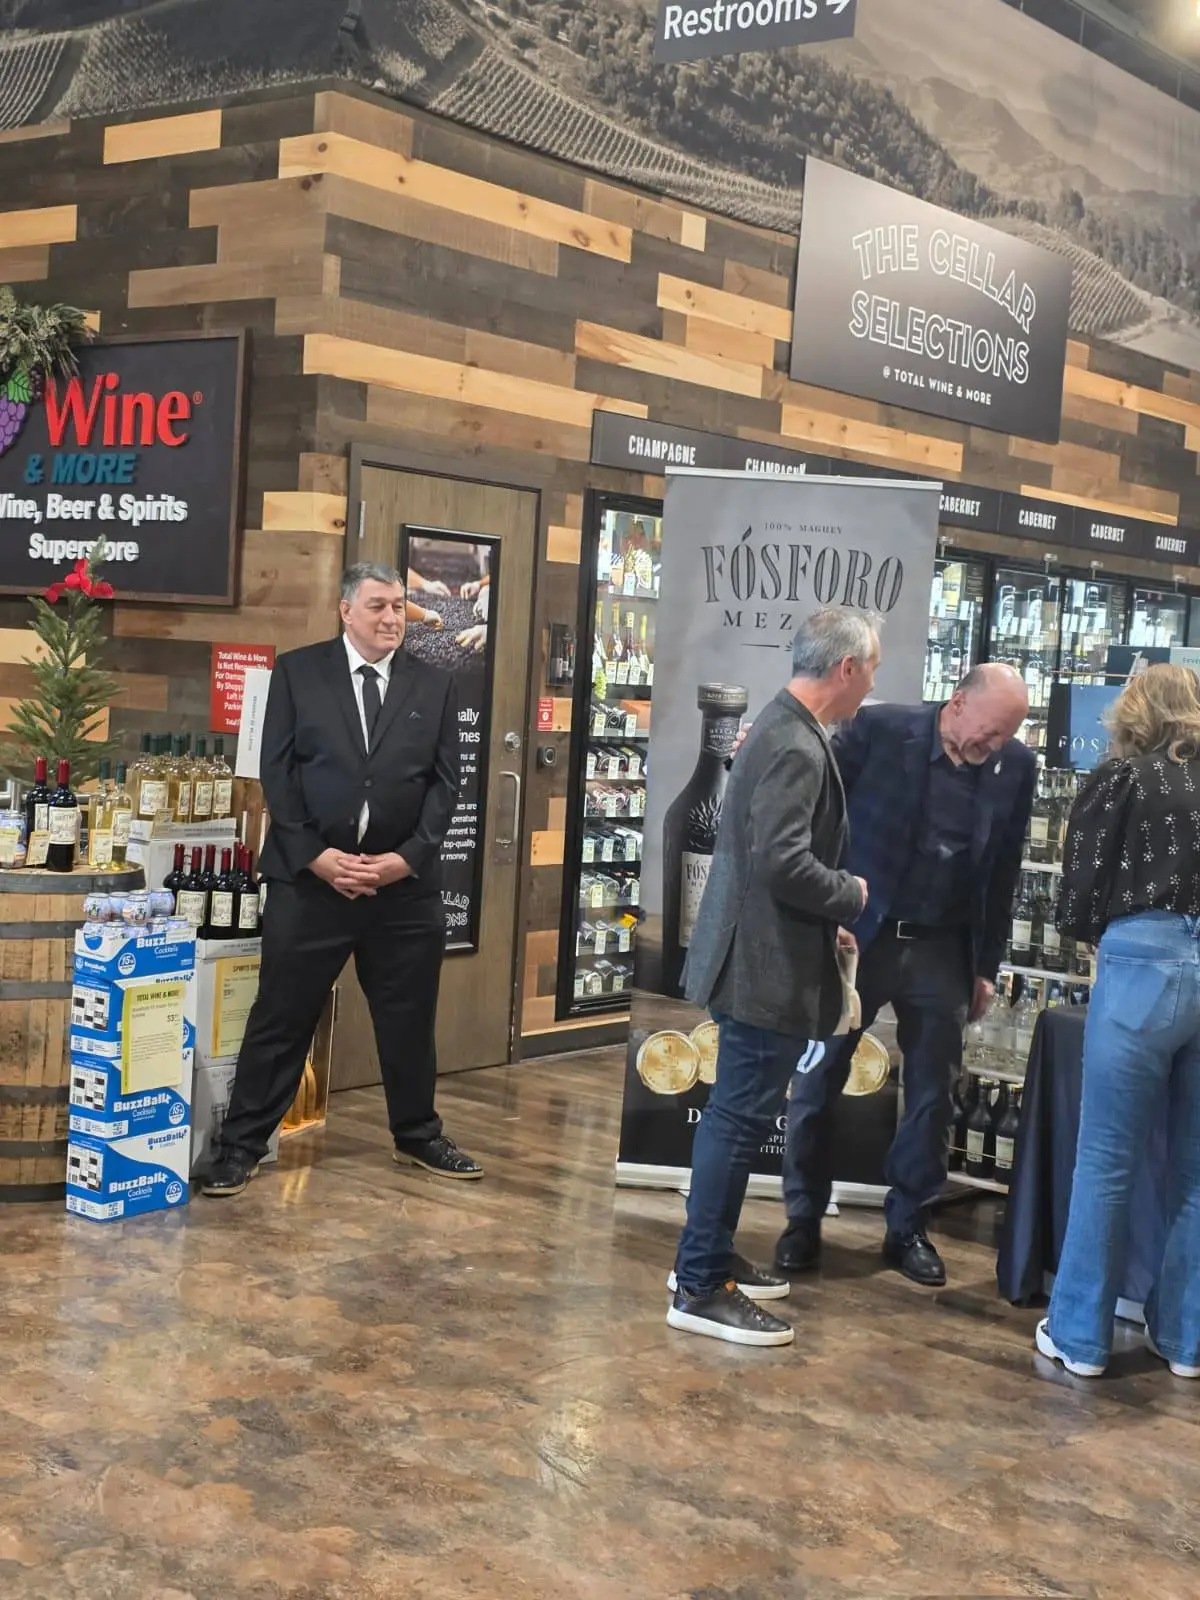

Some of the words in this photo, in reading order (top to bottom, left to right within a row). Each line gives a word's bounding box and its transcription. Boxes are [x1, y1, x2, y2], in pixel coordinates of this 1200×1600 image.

[664, 0, 818, 40] Restrooms
[852, 225, 919, 280] THE
[928, 229, 1036, 335] CELLAR
[848, 290, 1030, 384] SELECTIONS
[893, 367, 925, 388] TOTAL
[928, 376, 954, 396] WINE
[956, 382, 963, 397] &
[965, 384, 992, 406] MORE
[44, 372, 191, 446] Wine
[628, 435, 697, 466] CHAMPAGNE
[24, 453, 44, 483] &
[51, 453, 138, 484] MORE
[47, 493, 97, 520] Beer
[98, 493, 115, 520] &
[118, 494, 188, 526] Spirits
[939, 494, 981, 517] CABERNET
[1019, 509, 1057, 530] CABERNET
[799, 524, 842, 535] MAGUEY
[1090, 523, 1125, 543] CABERNET
[1155, 535, 1187, 554] CABERNET
[29, 532, 139, 564] Supersore
[700, 525, 904, 613] FÓSFORO
[722, 610, 793, 631] MEZ
